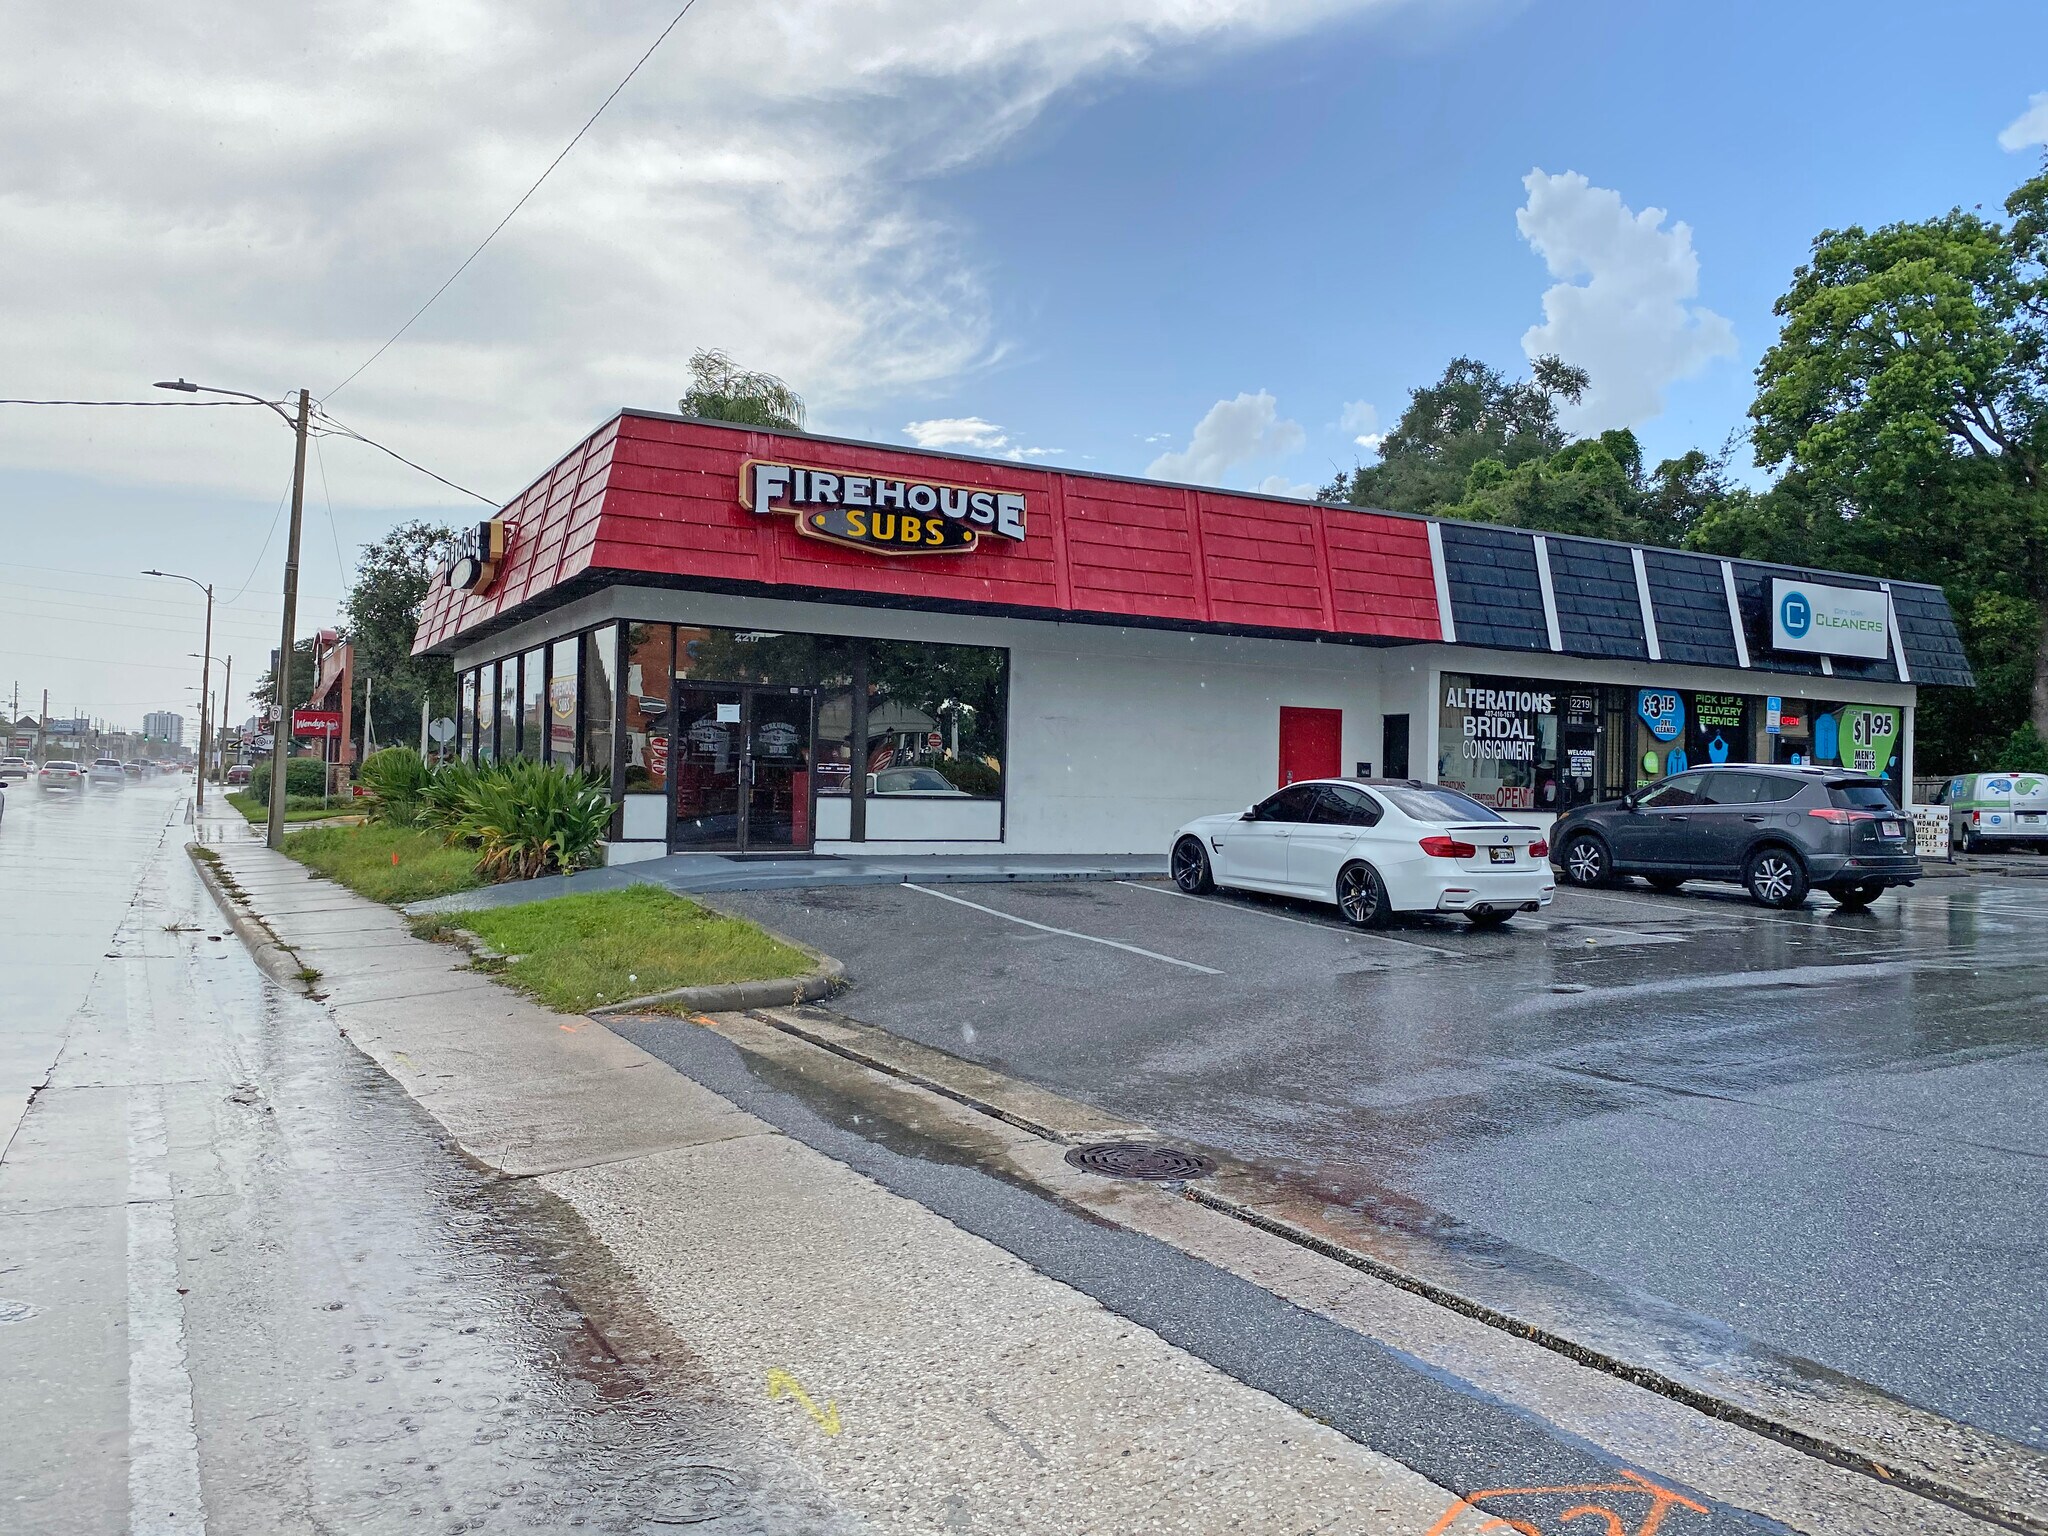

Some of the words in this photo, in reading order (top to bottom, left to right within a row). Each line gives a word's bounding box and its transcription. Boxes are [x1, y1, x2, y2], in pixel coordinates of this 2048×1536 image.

[753, 465, 1025, 541] FIREHOUSE
[846, 509, 944, 545] SUBS
[1815, 613, 1883, 632] CLEANERS
[1446, 688, 1551, 713] ALTERATIONS
[1571, 699, 1590, 709] 2219
[1696, 694, 1717, 704] PICK
[1736, 698, 1743, 706] &
[1697, 705, 1742, 716] DELIVERY
[297, 719, 325, 729] Wendy's
[1463, 716, 1535, 740] BRIDAL
[1699, 716, 1740, 726] SERVICE
[1781, 717, 1799, 726] OPEN
[1854, 713, 1892, 745] $1.95
[1462, 739, 1535, 761] CONSIGNMENT
[1854, 750, 1876, 760] MEN'S
[1854, 760, 1876, 769] SHIRTS
[1496, 787, 1525, 808] OPEN
